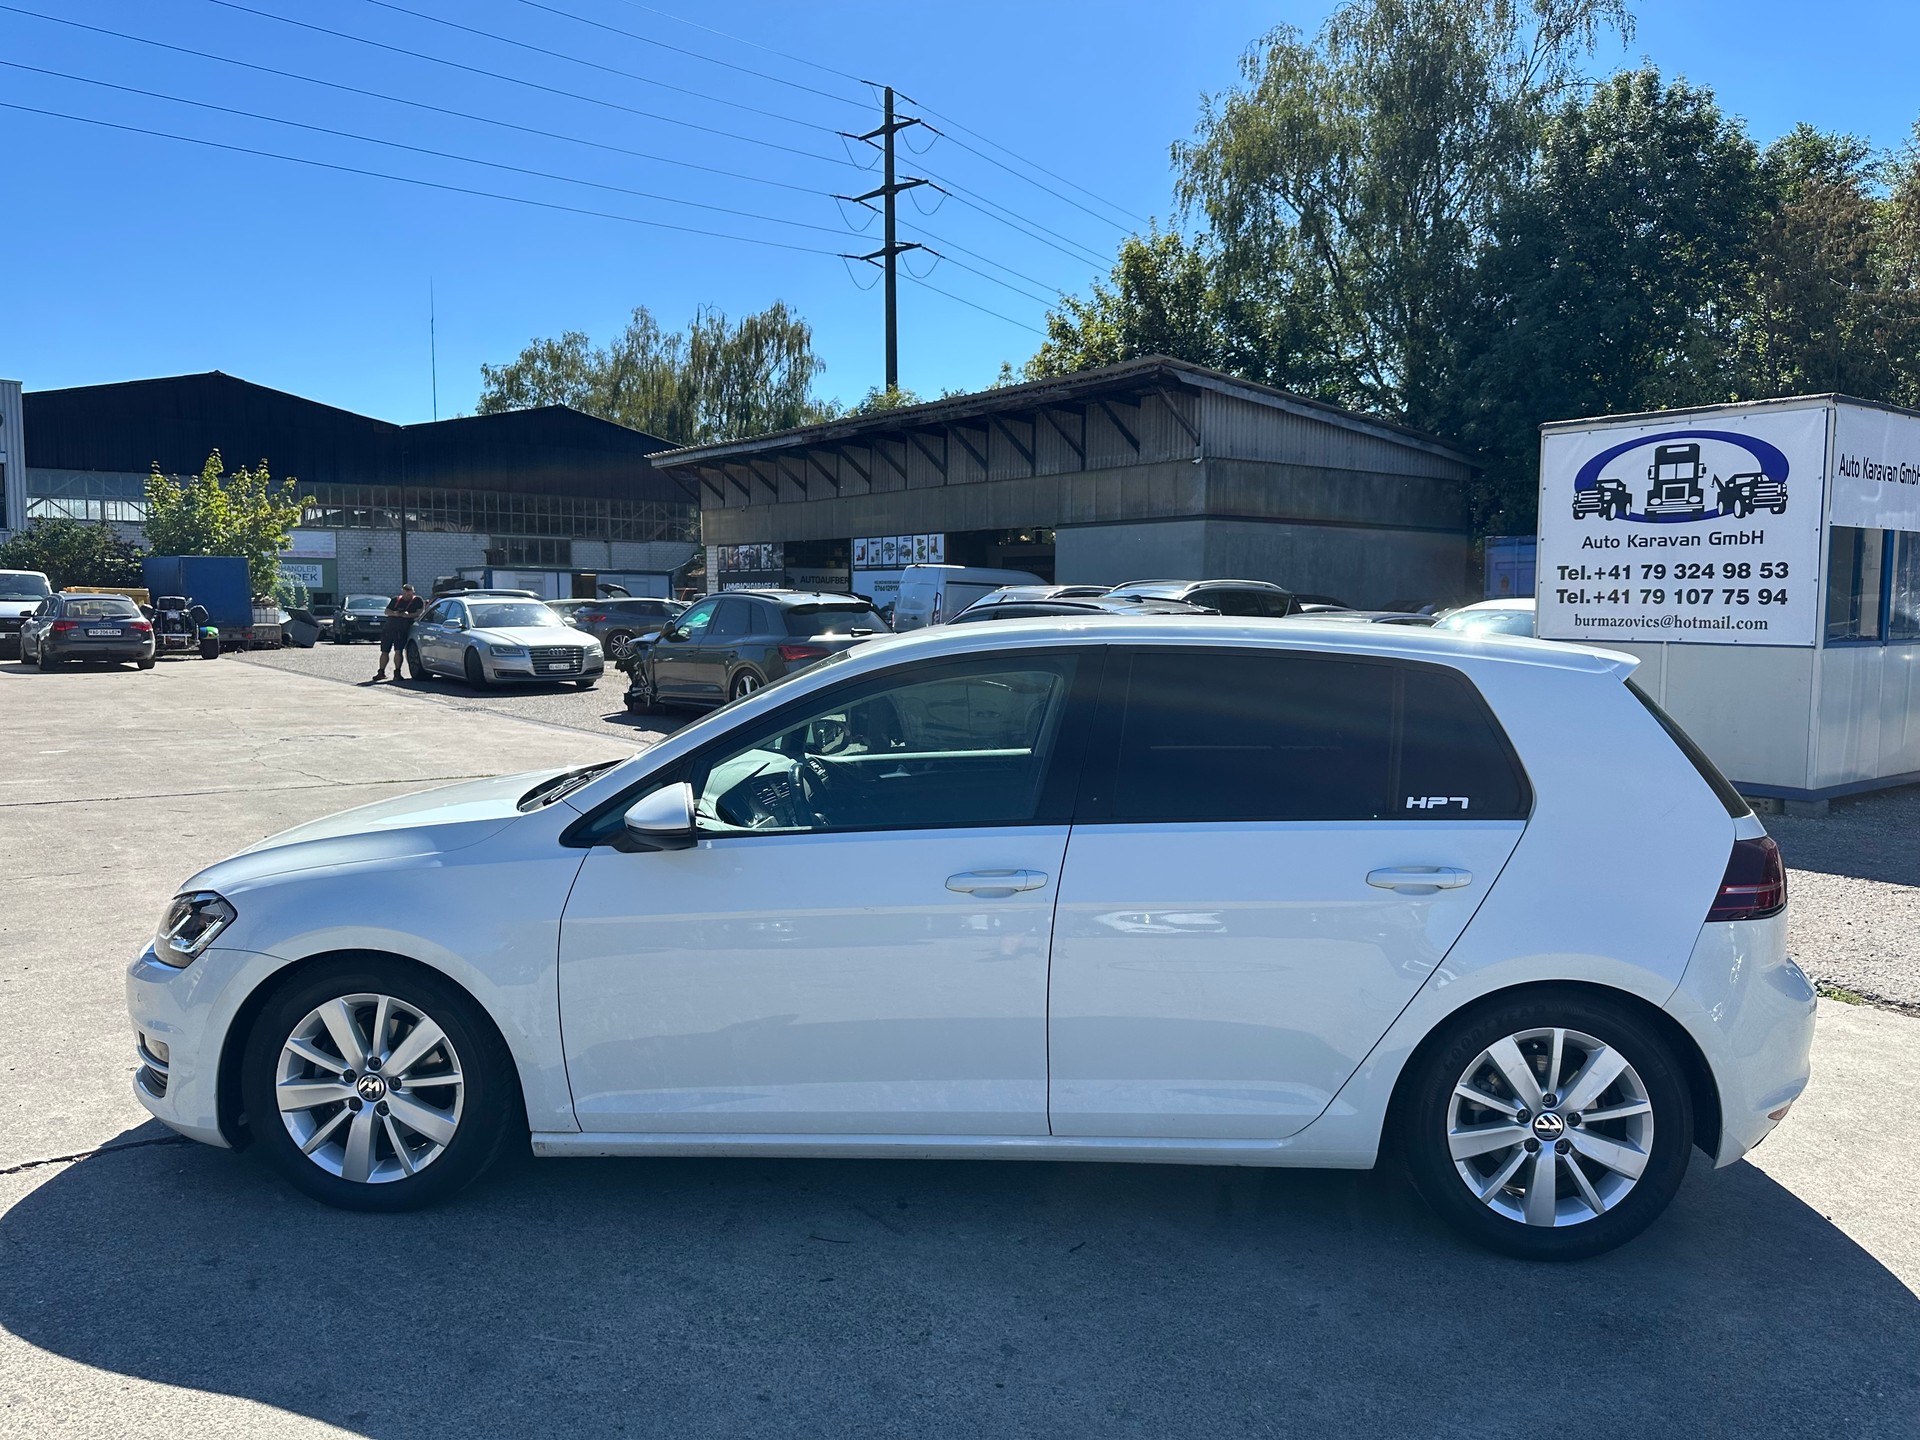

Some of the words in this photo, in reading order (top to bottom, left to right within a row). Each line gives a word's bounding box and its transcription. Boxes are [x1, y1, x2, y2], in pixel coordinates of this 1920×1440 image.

[1839, 453, 1860, 478] Auto
[1862, 456, 1898, 482] Karavan
[1581, 536, 1620, 549] Auto
[1627, 534, 1701, 548] Karavan
[1708, 530, 1764, 546] GmbH
[1641, 563, 1667, 579] 79
[1674, 563, 1715, 579] 324
[1722, 562, 1751, 579] 98
[1759, 562, 1789, 579] 53
[1640, 589, 1666, 604] 79
[1674, 588, 1714, 604] 107
[1722, 588, 1750, 605] 75
[1757, 589, 1788, 605] 94
[1574, 613, 1768, 630] burmazovics@hotmail.com
[1406, 797, 1469, 809] HP7
